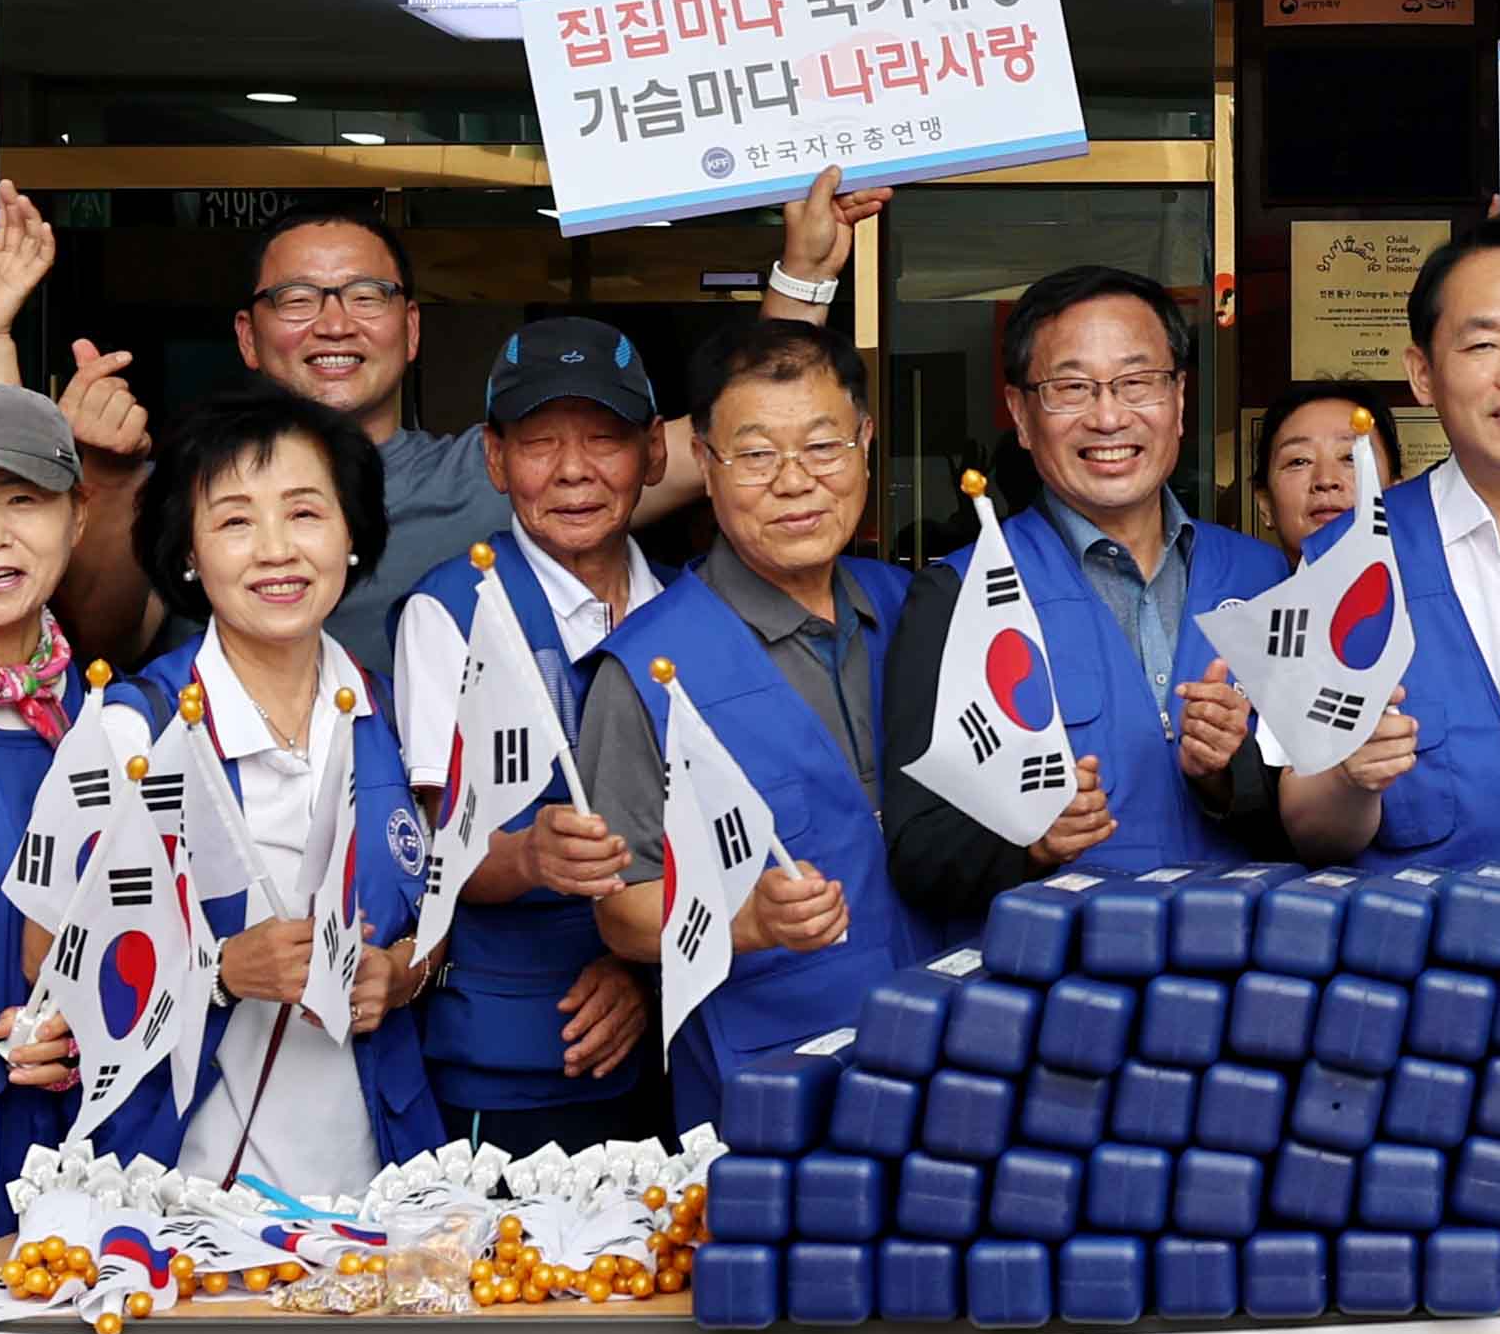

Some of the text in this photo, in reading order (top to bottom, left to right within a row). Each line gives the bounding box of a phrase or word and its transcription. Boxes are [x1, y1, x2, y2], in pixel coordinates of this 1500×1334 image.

[573, 24, 1038, 142] 가슴마다 나라사랑
[745, 116, 943, 169] 한국자유총연맹
[706, 156, 729, 169] KFF
[1386, 236, 1408, 244] Child
[1386, 246, 1421, 255] Friendly
[1386, 256, 1411, 264] Cities
